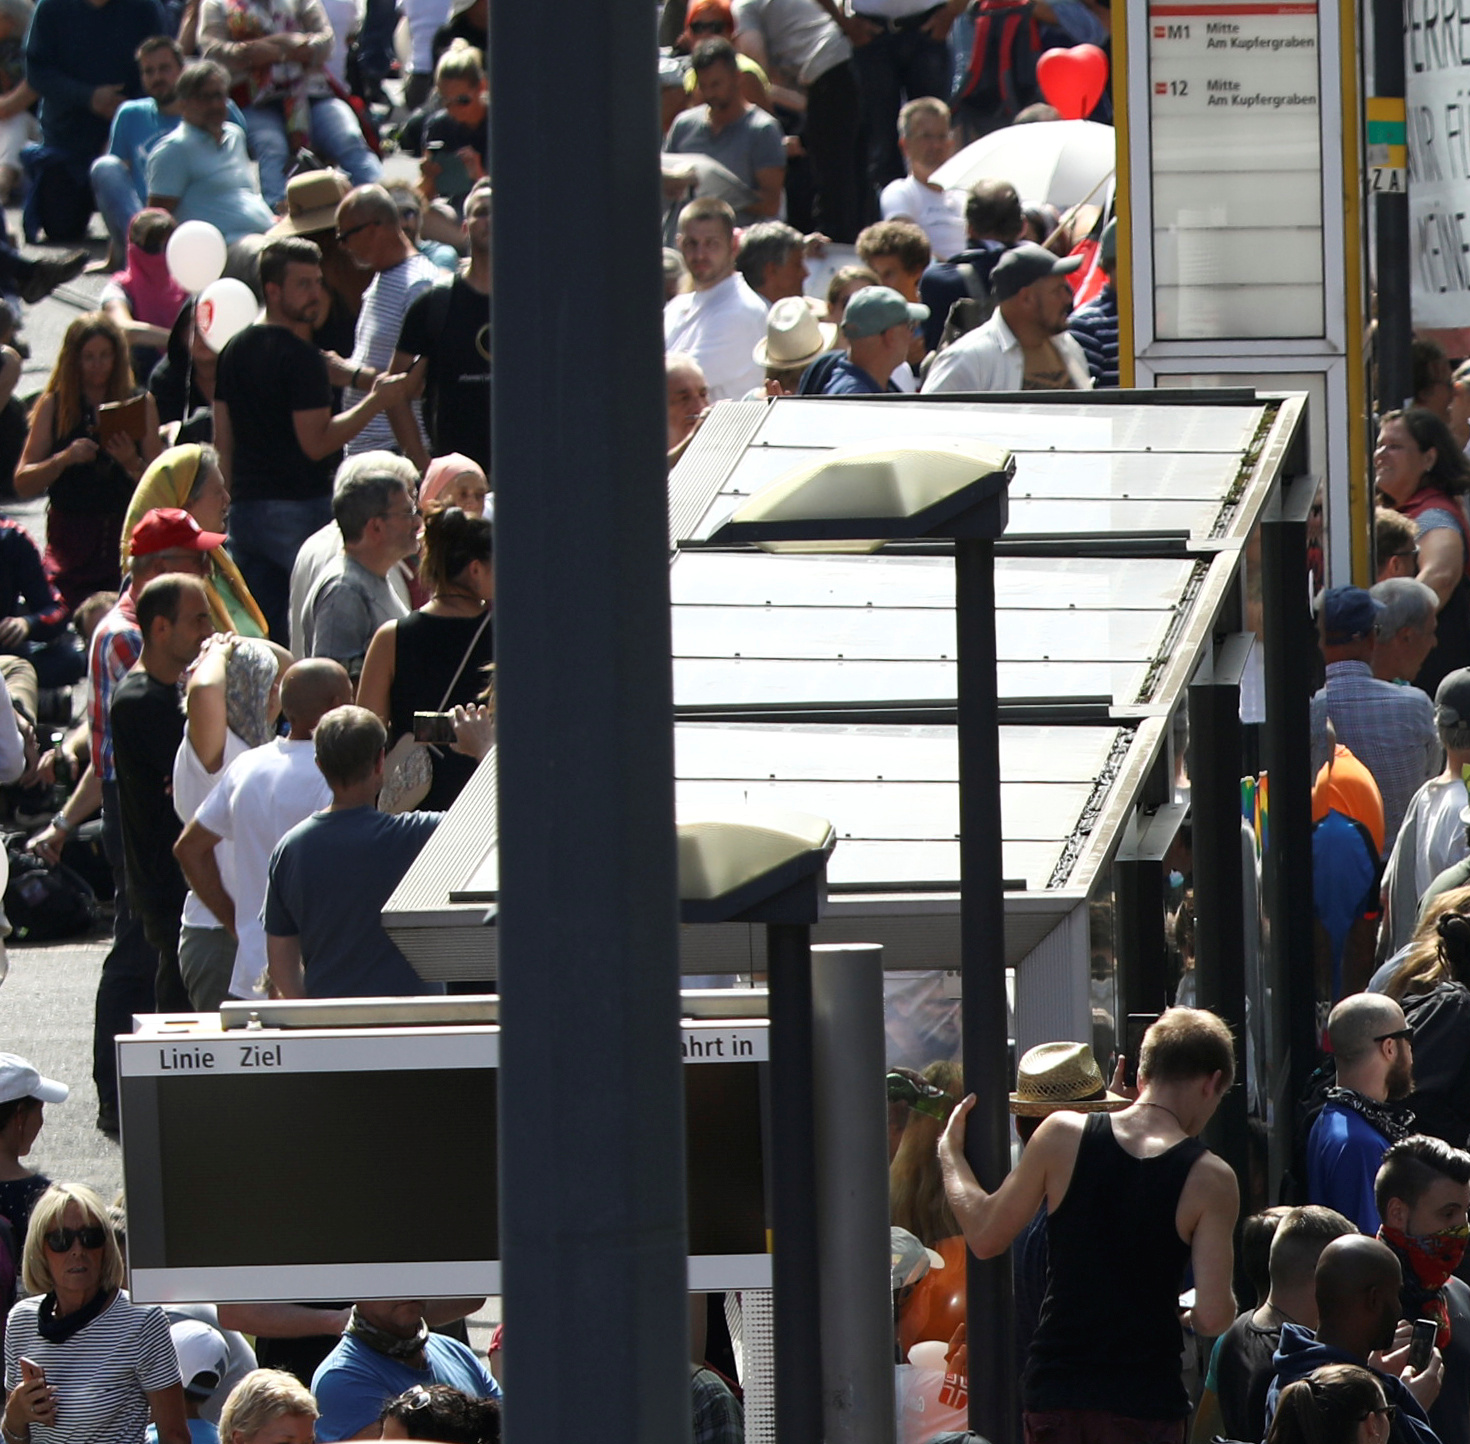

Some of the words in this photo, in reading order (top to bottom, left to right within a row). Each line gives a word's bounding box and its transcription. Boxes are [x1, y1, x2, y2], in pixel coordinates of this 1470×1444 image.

[1167, 25, 1191, 39] M1
[1206, 23, 1240, 35] Mitte
[1207, 38, 1227, 49] Am
[1230, 37, 1315, 51] Kupfergraben
[1169, 80, 1189, 96] 12
[1207, 79, 1241, 91] Mitte
[1207, 95, 1229, 106] Am
[1231, 93, 1317, 108] Kupfergraben
[159, 1047, 215, 1070] Linie
[240, 1045, 282, 1067] Ziel
[732, 1034, 754, 1057] in
